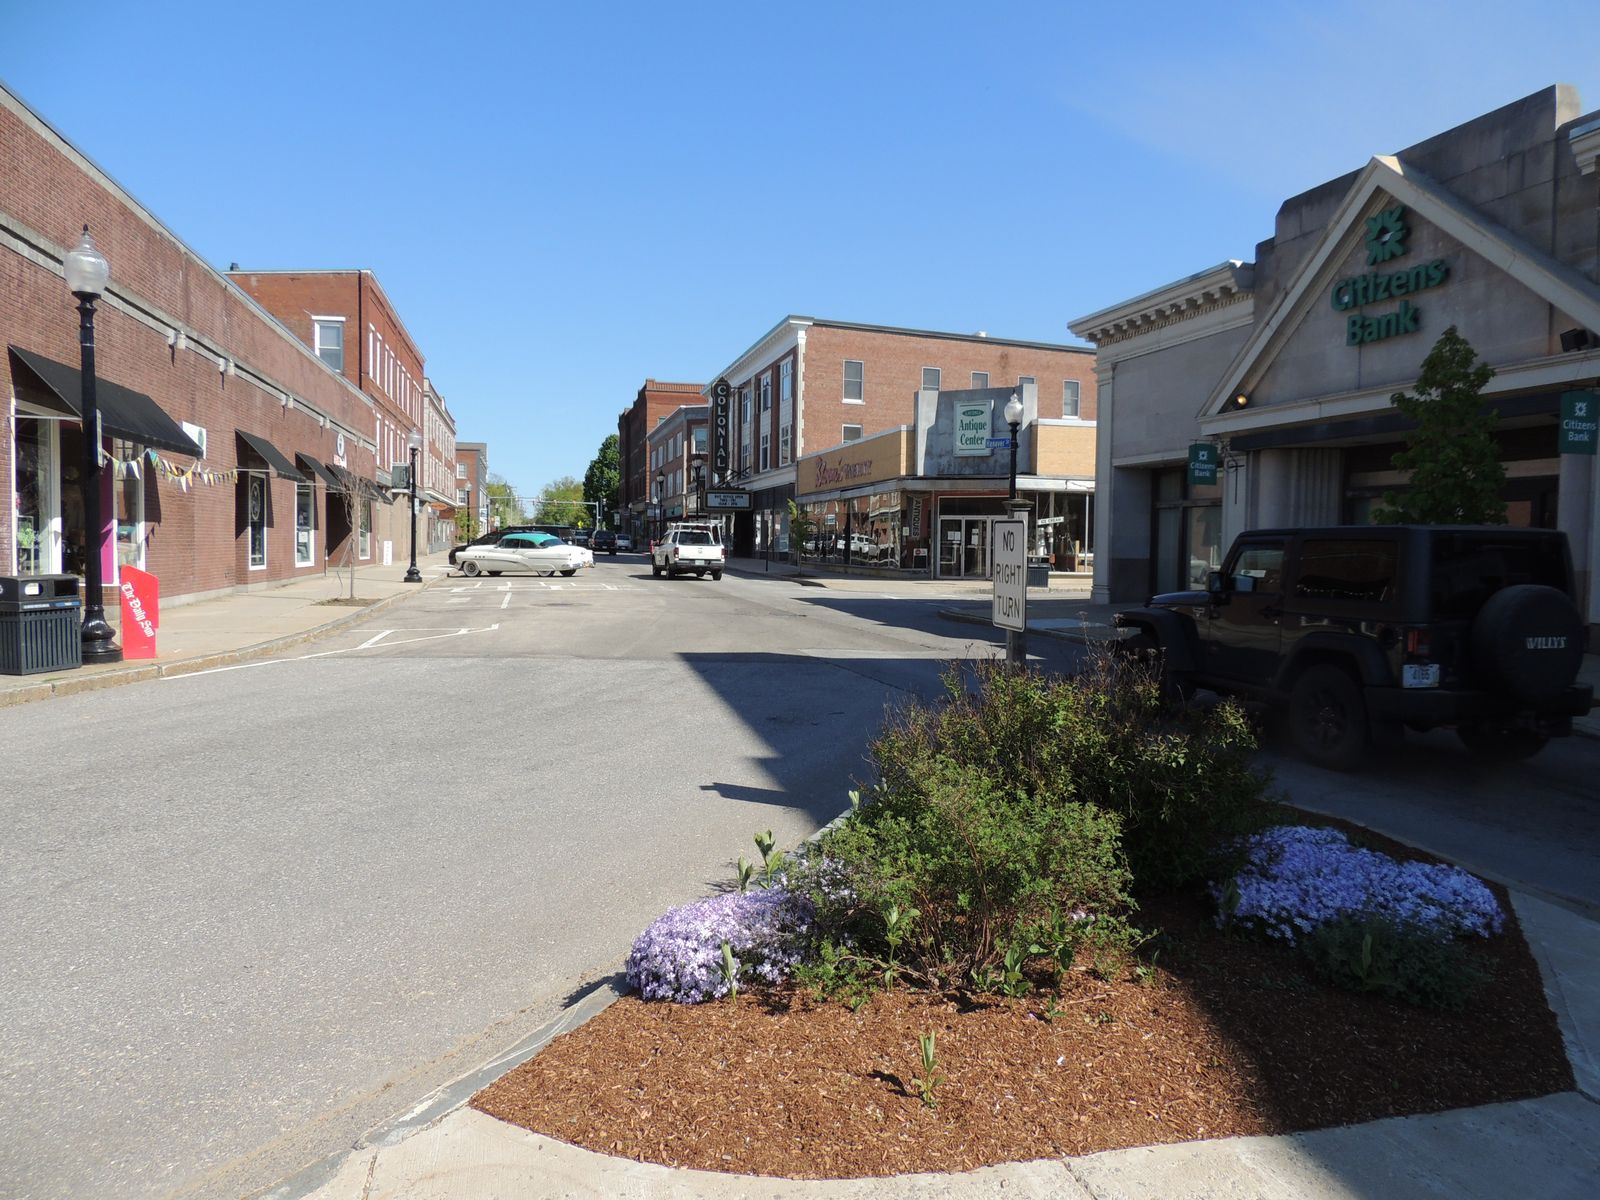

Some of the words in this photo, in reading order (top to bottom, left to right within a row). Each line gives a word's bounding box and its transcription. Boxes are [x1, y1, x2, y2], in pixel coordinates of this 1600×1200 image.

[1331, 258, 1447, 311] Citizens
[1346, 300, 1419, 347] Bank
[717, 385, 727, 467] COLONIAL
[959, 418, 987, 434] Antique
[1563, 419, 1597, 431] Citizens
[1568, 431, 1590, 441] Bank
[960, 433, 985, 446] Center
[912, 499, 921, 537] ANTIQUES
[1003, 531, 1015, 552] NO
[995, 563, 1021, 586] RIGHT
[121, 581, 135, 600] The
[129, 597, 147, 622] Daily
[138, 620, 155, 637] Sun
[997, 595, 1020, 619] TURN
[1526, 636, 1567, 649] WILLYS
